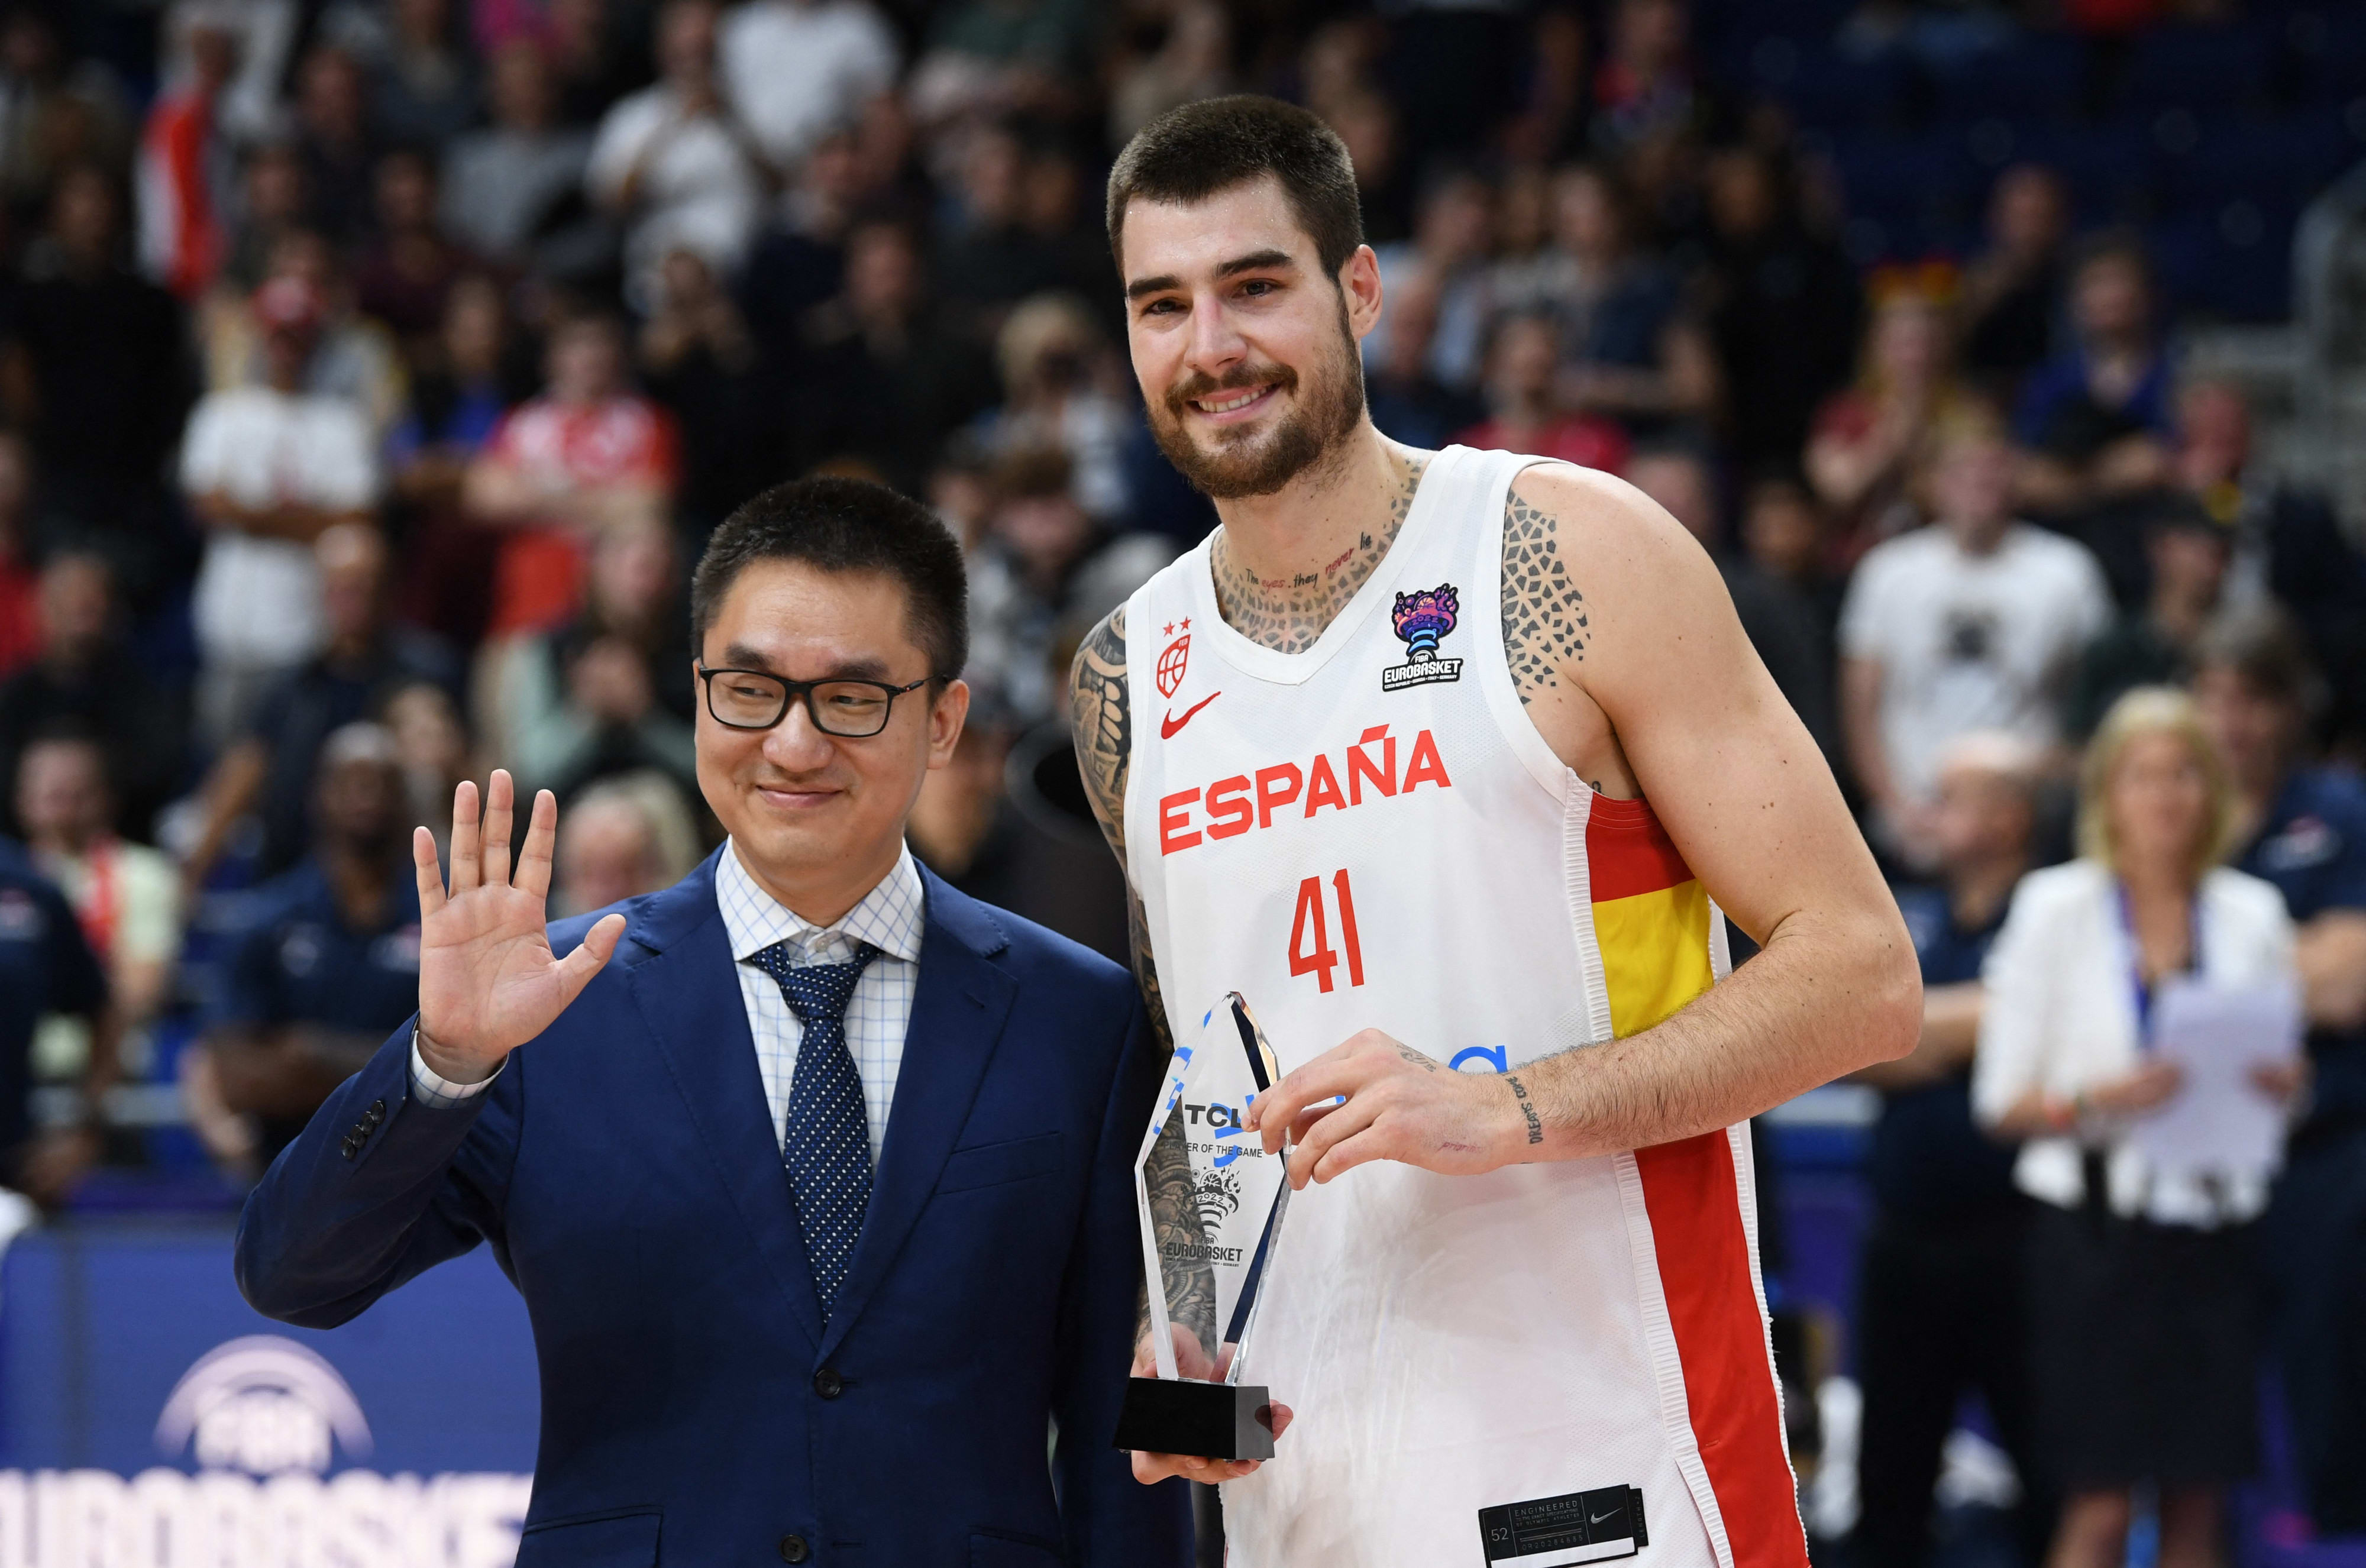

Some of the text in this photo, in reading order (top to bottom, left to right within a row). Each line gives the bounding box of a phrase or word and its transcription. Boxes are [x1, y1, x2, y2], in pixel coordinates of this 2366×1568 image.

[1246, 568, 1259, 585] The
[1294, 573, 1318, 588] they
[1325, 548, 1355, 575] never
[1360, 532, 1371, 551] lie
[1411, 615, 1439, 626] 2022
[1415, 655, 1428, 663] FIBA
[1385, 661, 1460, 683] EUROBASKET
[1159, 723, 1452, 856] ESPAÑA
[1288, 868, 1365, 994] 41
[1184, 1104, 1242, 1129] TCL
[1201, 1143, 1213, 1153] OF
[1216, 1145, 1233, 1156] THE
[1236, 1147, 1262, 1158] GAME
[1198, 1193, 1224, 1205] 2022
[1166, 1242, 1243, 1262] EUROBASKET
[1514, 1500, 1578, 1517] ENGINEERED
[1553, 1512, 1580, 1521] ATHLETES
[1491, 1527, 1508, 1542] 52
